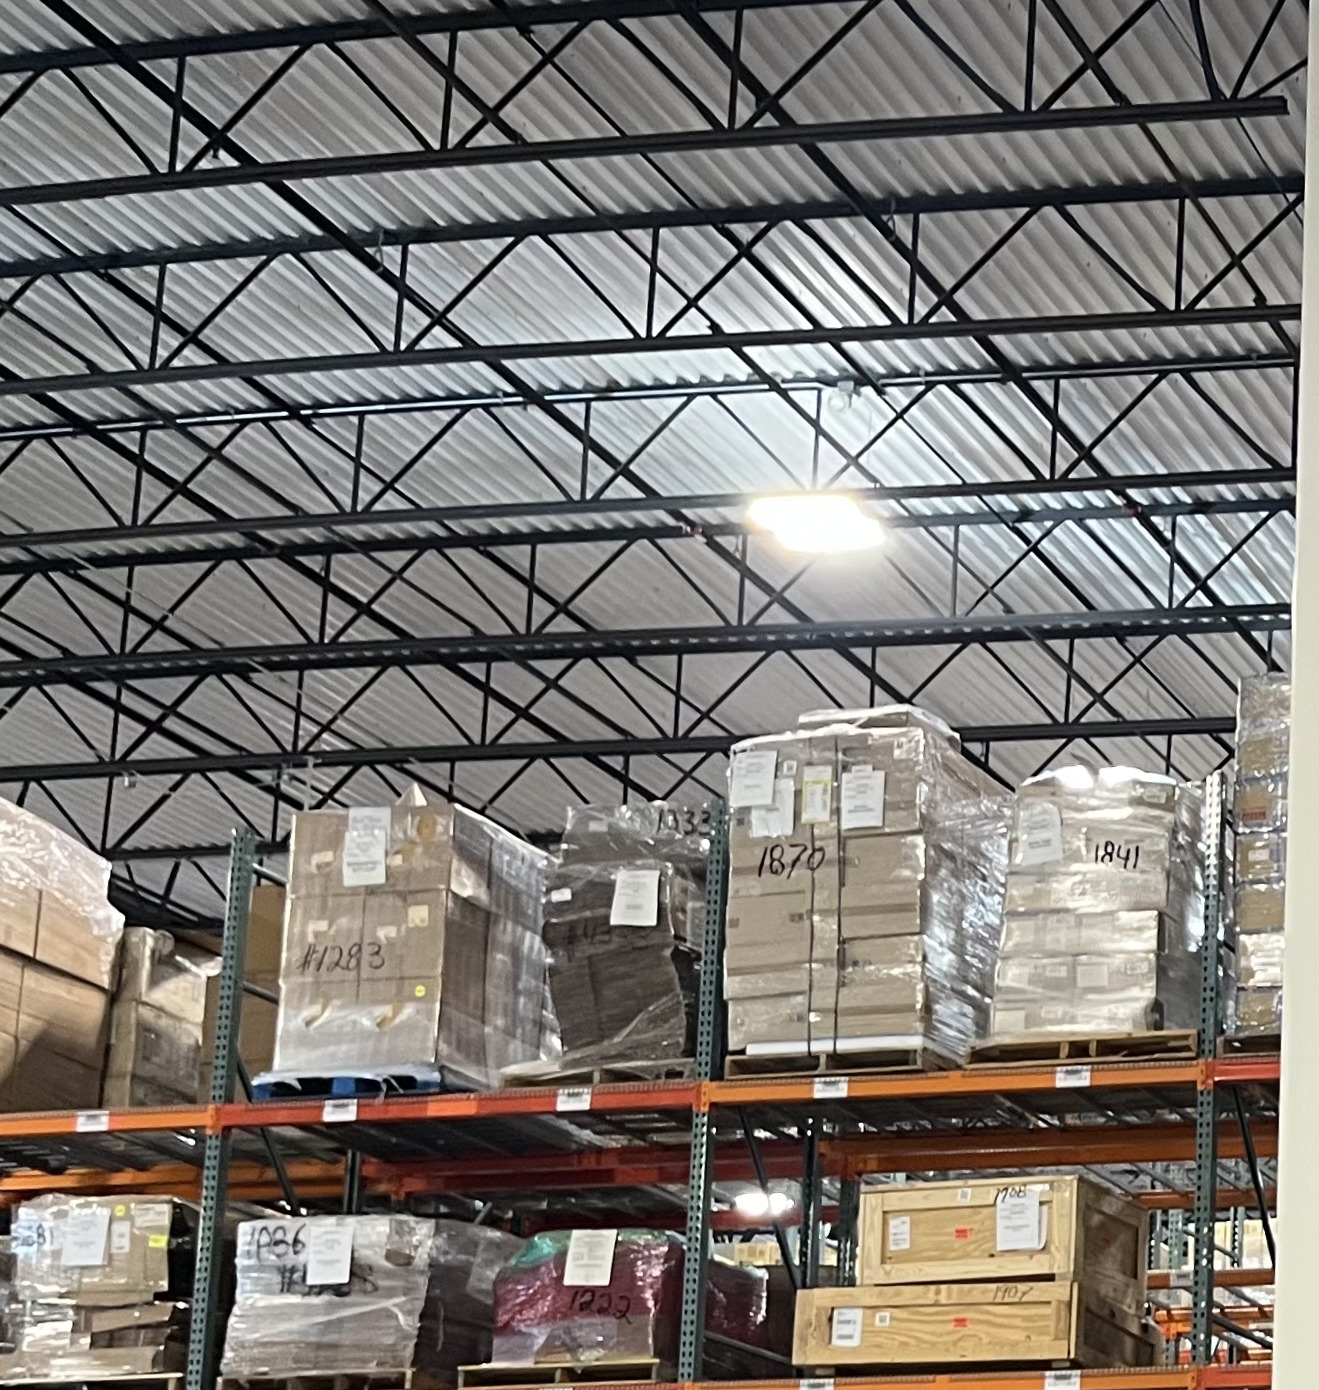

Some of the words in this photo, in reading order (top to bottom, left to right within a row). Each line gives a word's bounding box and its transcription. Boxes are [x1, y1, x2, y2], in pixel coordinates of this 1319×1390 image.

[757, 843, 826, 880] 1870
[1094, 840, 1140, 869] 1841
[296, 941, 386, 973] #1283
